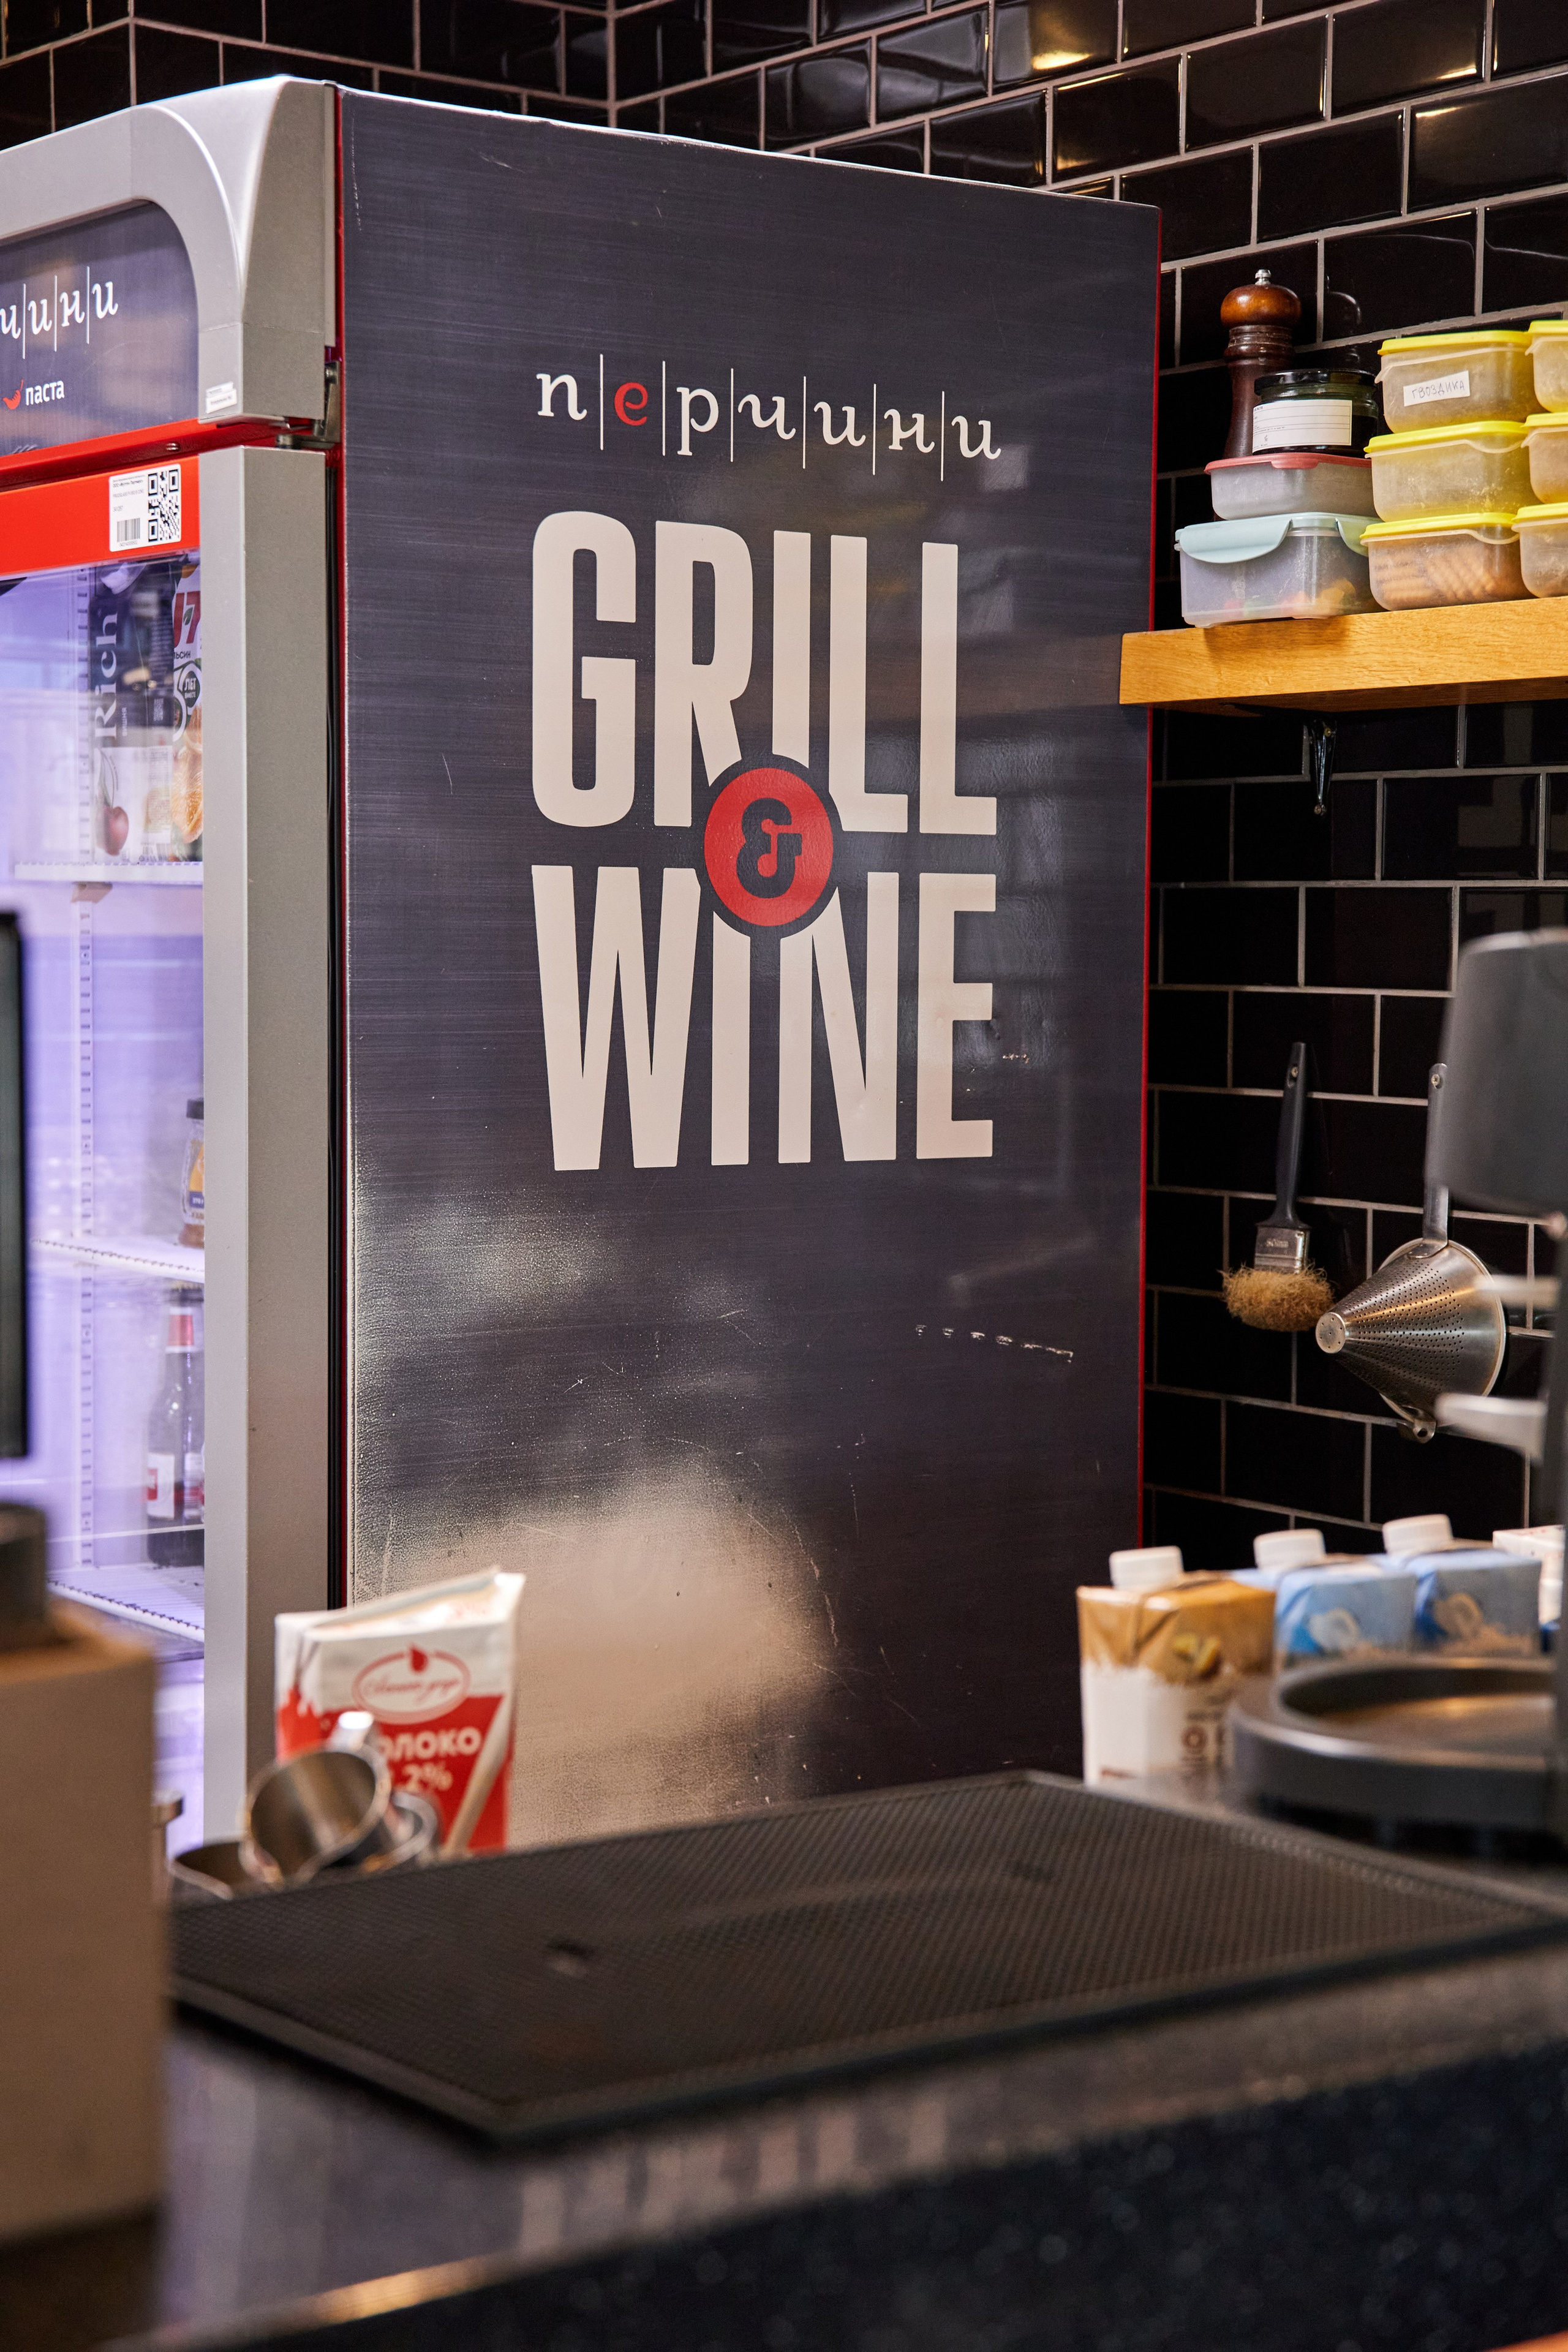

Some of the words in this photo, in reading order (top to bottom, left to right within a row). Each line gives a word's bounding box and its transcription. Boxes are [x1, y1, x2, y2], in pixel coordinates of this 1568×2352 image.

[25, 380, 65, 405] паста
[1412, 380, 1465, 399] ГВОЗДИКА
[94, 612, 118, 739] Rich
[532, 510, 997, 835] GRILL
[736, 797, 803, 900] &
[531, 864, 997, 1171] WINE
